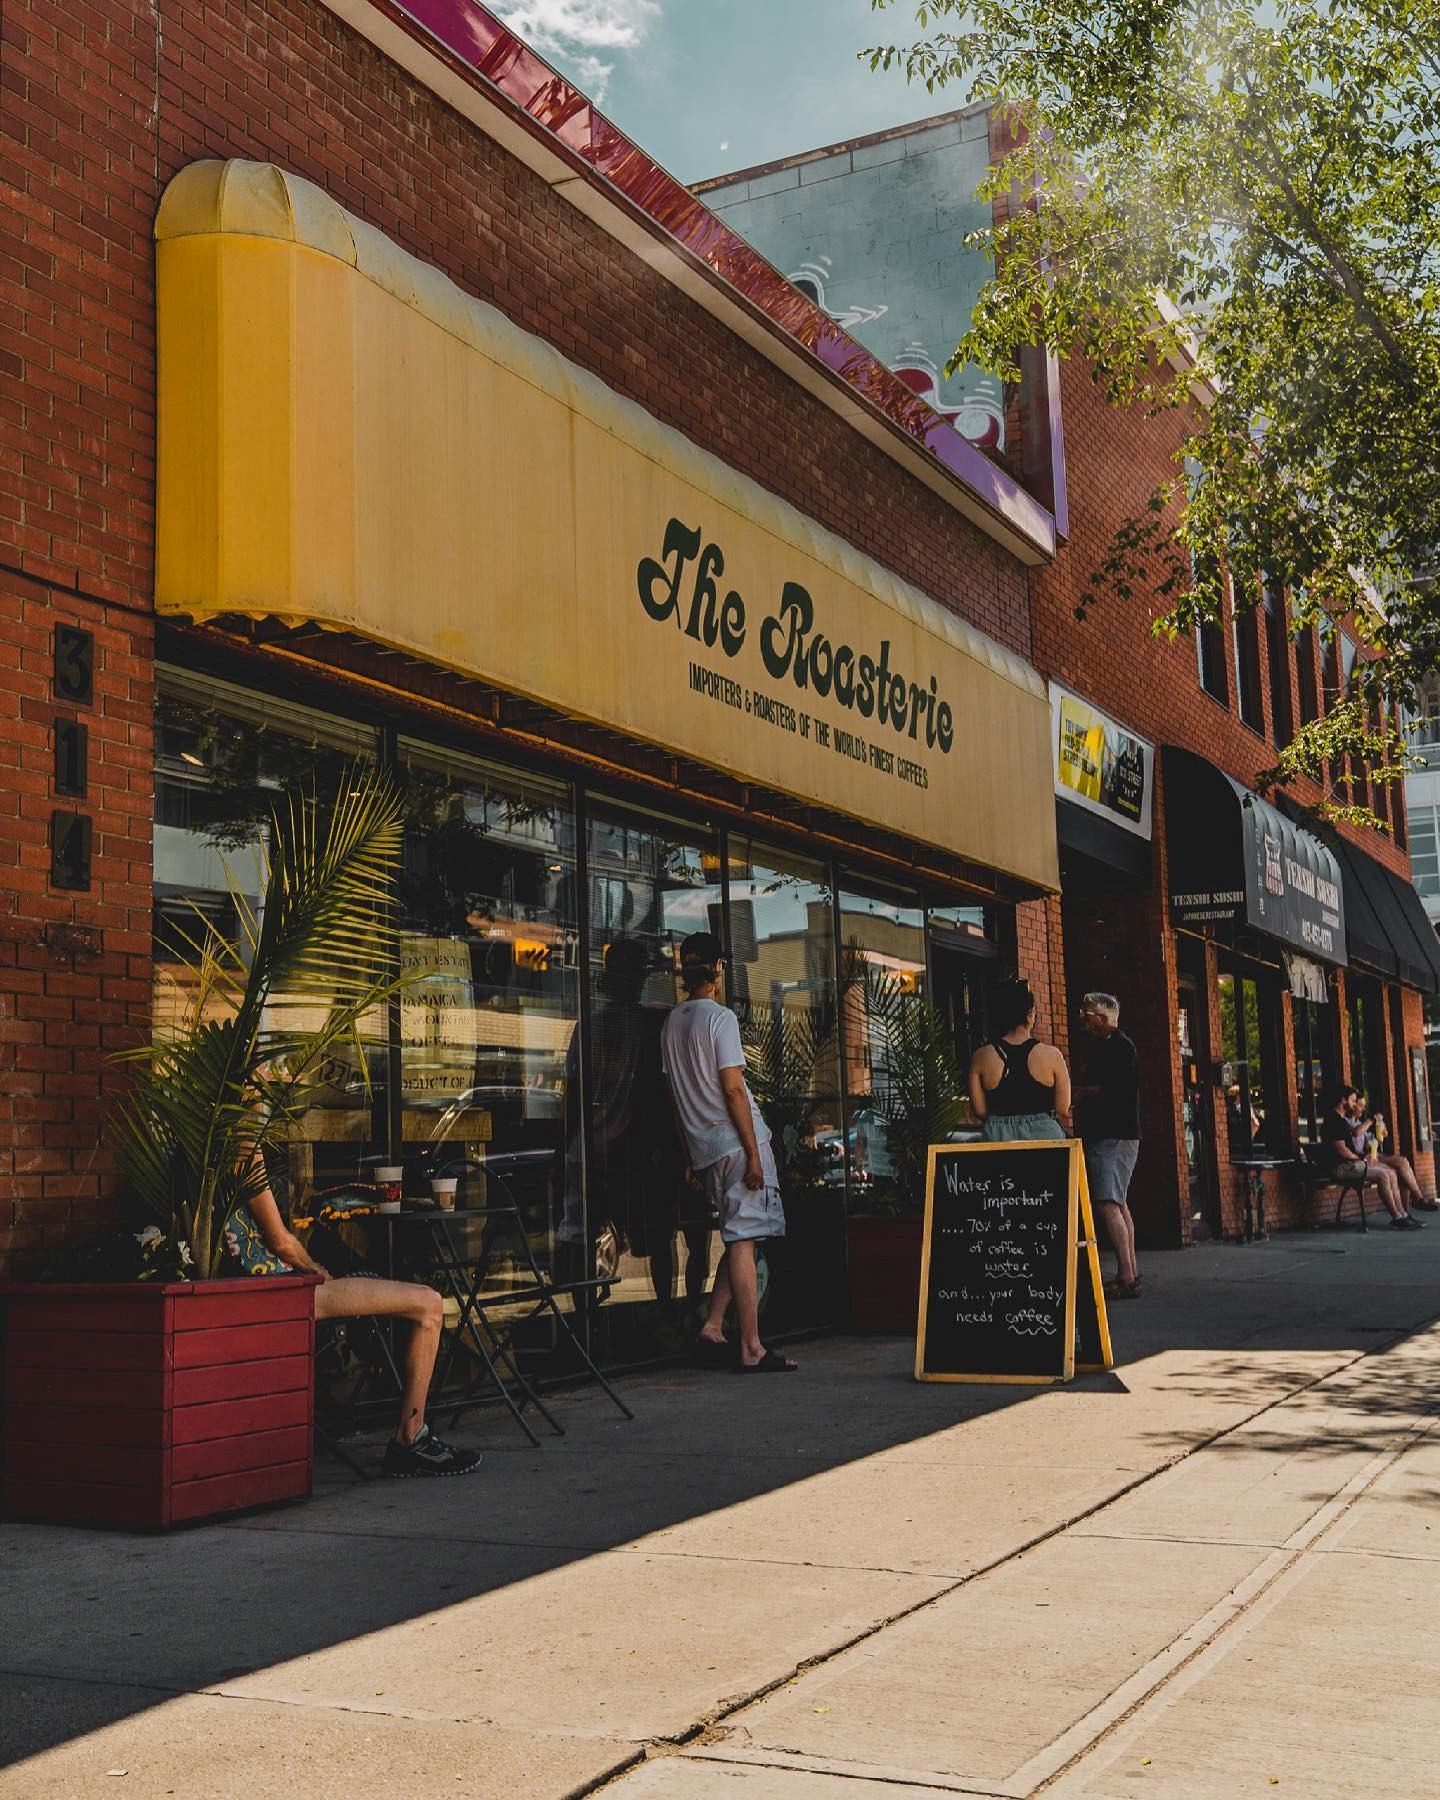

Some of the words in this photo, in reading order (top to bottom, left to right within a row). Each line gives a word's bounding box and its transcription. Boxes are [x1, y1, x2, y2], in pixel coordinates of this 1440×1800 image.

[637, 517, 746, 657] The
[760, 581, 953, 753] Roasterie
[689, 661, 742, 710] IMPORTERS
[745, 688, 752, 713] &
[753, 691, 796, 734] ROASTERS
[800, 711, 811, 738] OF
[814, 718, 830, 748] THE
[834, 728, 867, 764] WORLD'S
[869, 744, 895, 777] FINEST
[897, 756, 928, 790] COFFEES
[1213, 890, 1244, 904] SUSHI
[1317, 876, 1339, 912] SUSHI
[943, 1162, 991, 1196] Water
[1000, 1174, 1015, 1190] is
[983, 1190, 1053, 1217] important
[998, 1218, 1011, 1231] of
[1019, 1223, 1027, 1231] a
[1036, 1220, 1058, 1239] cup
[969, 1240, 982, 1254] of
[988, 1240, 1025, 1255] coffee
[1034, 1242, 1048, 1256] is
[985, 1260, 1030, 1273] water
[1028, 1285, 1064, 1307] body
[956, 1311, 993, 1323] needs
[1005, 1309, 1054, 1325] coffee
